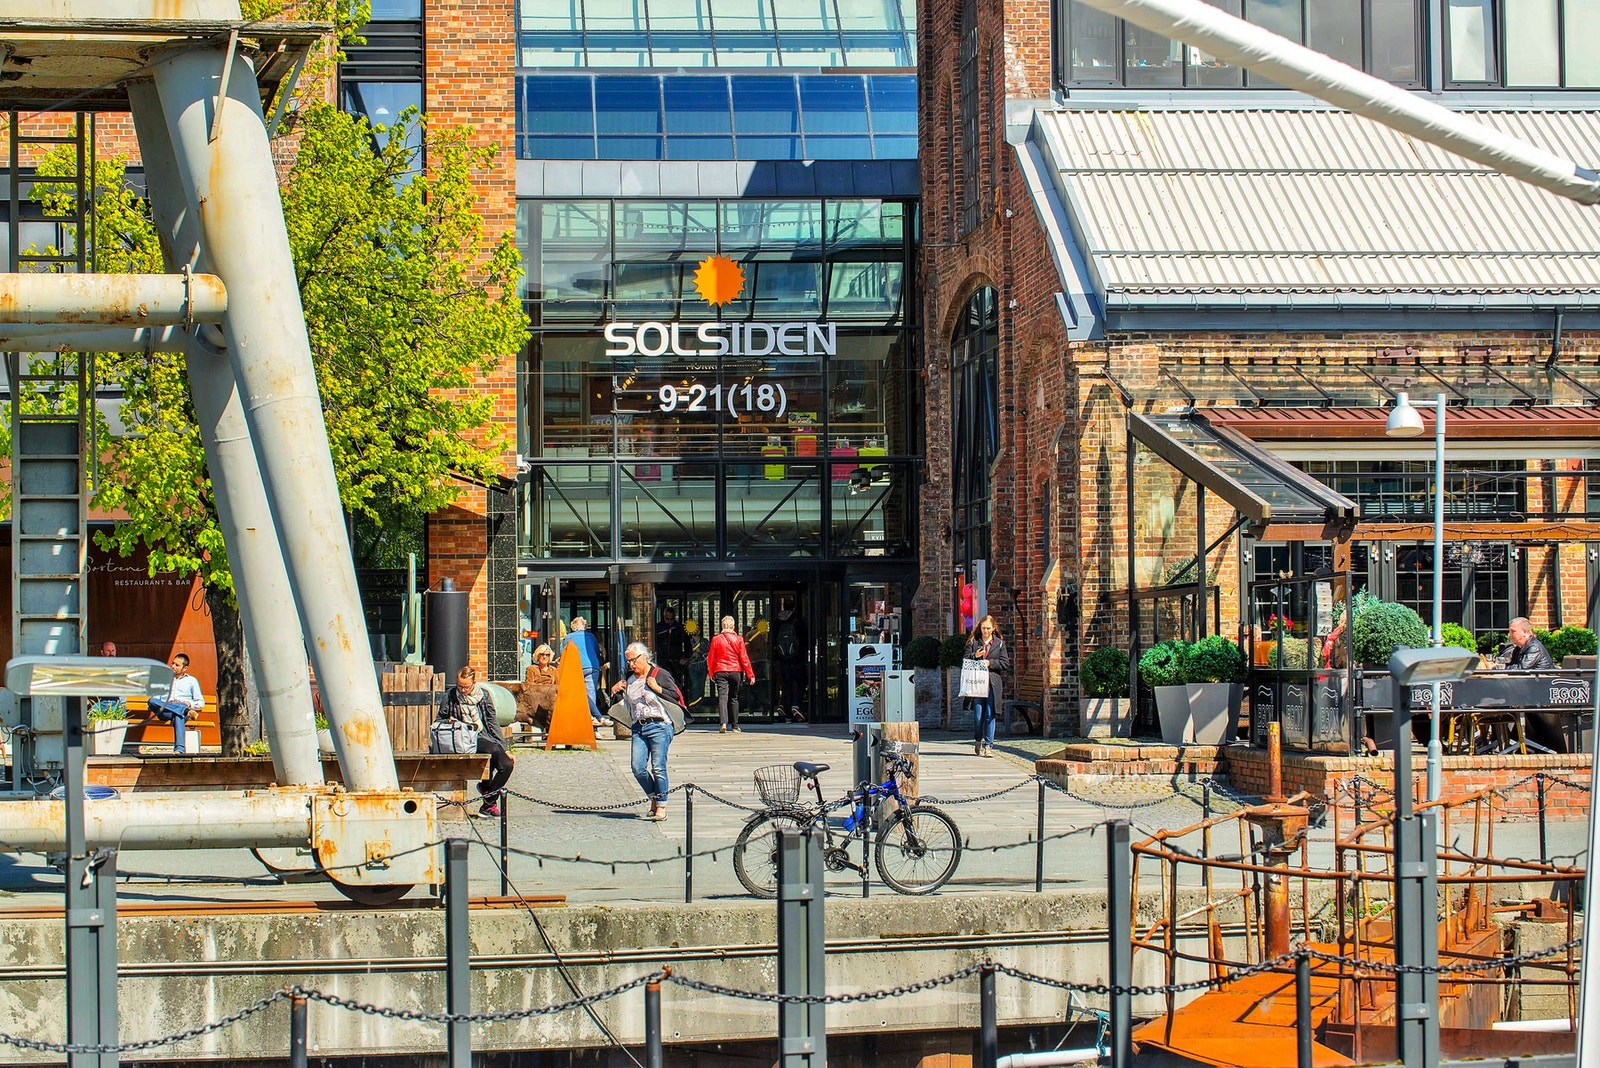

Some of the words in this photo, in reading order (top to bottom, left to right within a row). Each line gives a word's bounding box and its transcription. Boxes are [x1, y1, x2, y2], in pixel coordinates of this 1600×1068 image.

[603, 321, 837, 357] SOLSIDEN
[658, 382, 788, 418] 9-21(18)
[1411, 689, 1453, 702] EGN
[1549, 687, 1590, 700] EGON
[856, 707, 874, 716] EG
